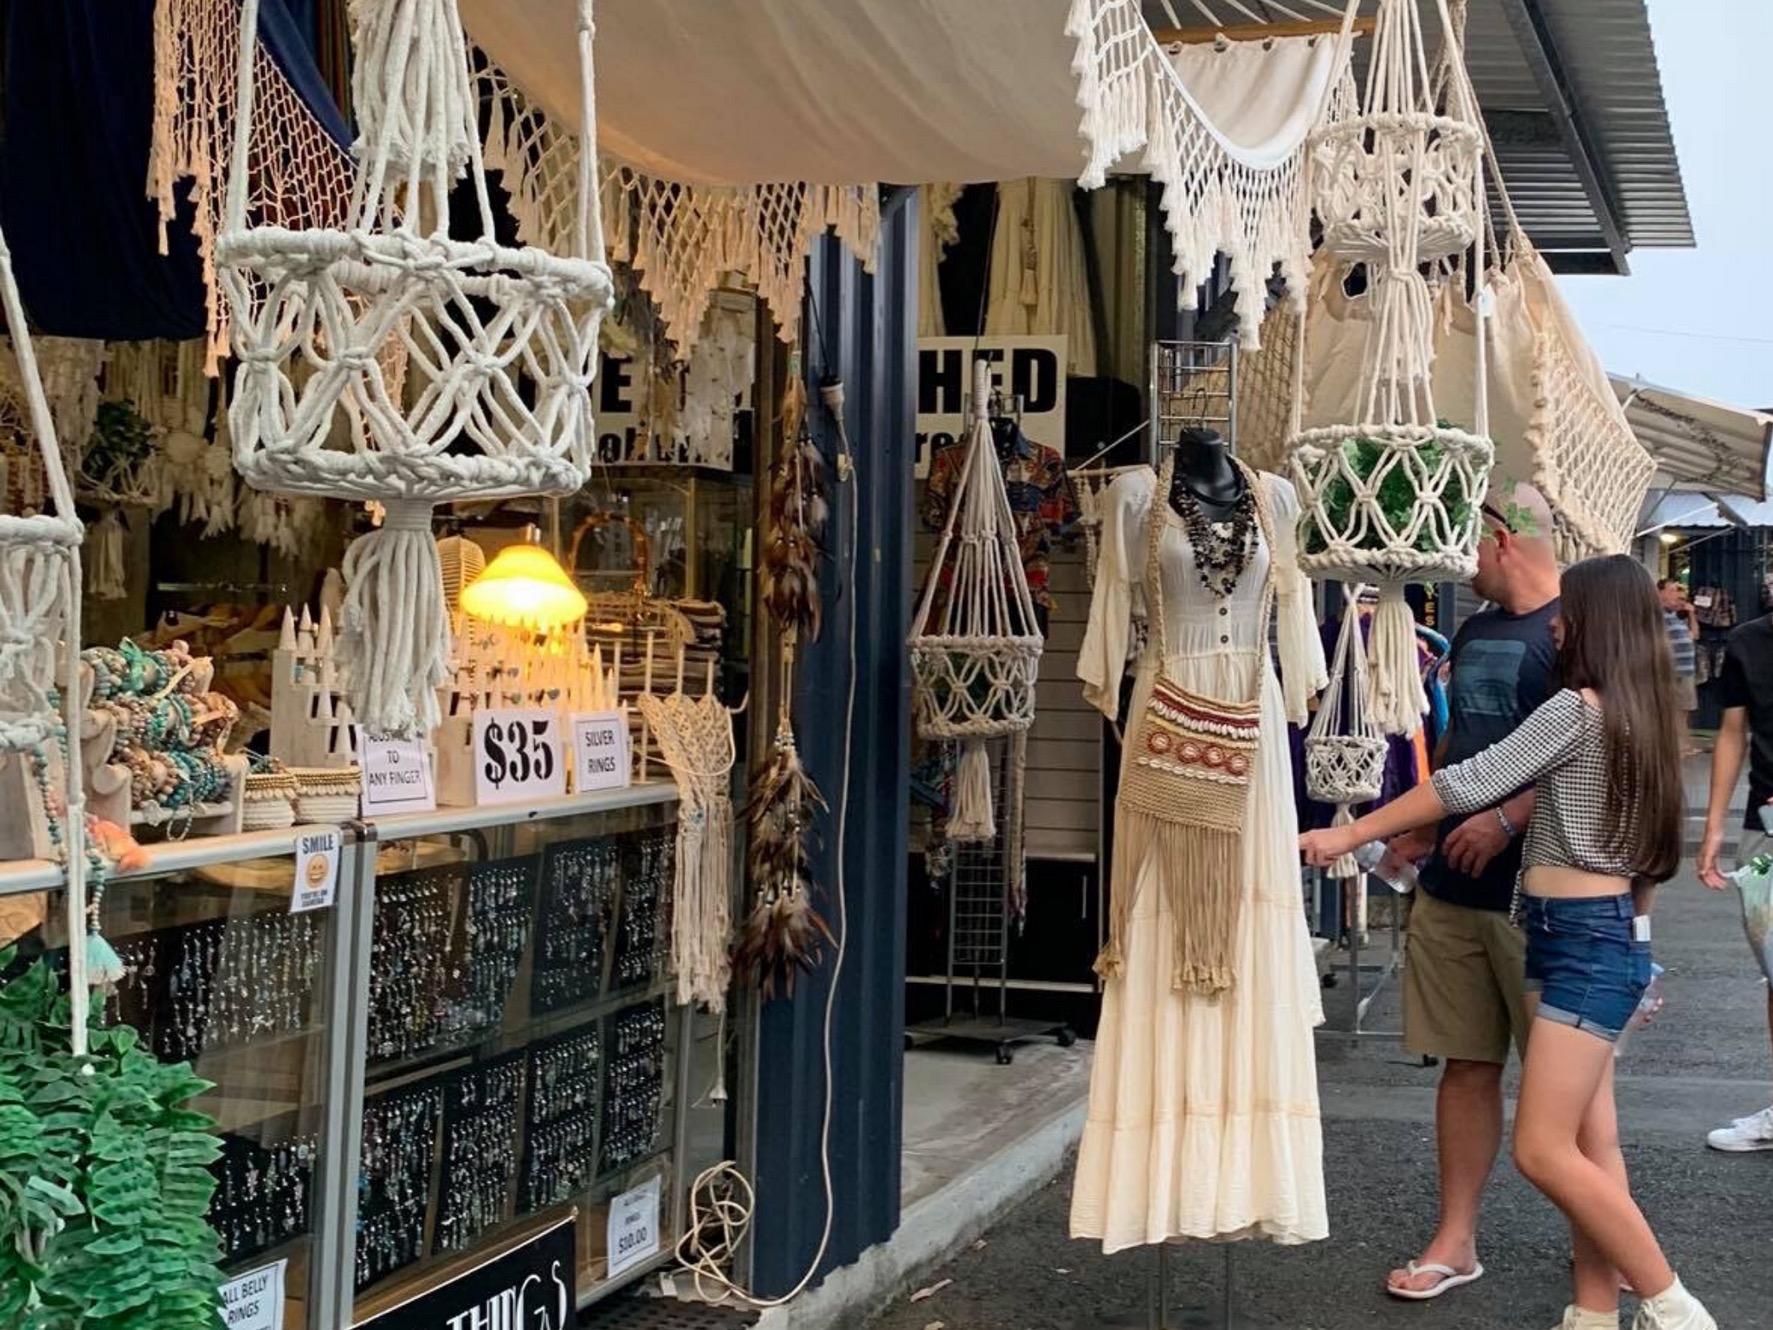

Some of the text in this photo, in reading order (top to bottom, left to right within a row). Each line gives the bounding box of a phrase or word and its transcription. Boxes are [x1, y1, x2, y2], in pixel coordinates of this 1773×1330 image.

[585, 729, 615, 747] SILVER
[386, 749, 400, 764] TO
[484, 717, 554, 790] $35
[587, 756, 616, 774] RINGS
[369, 770, 421, 785] ANY FINGER
[302, 834, 334, 854] SMILE
[222, 1275, 268, 1309] ALL BELLY
[227, 1300, 260, 1325] RINGS
